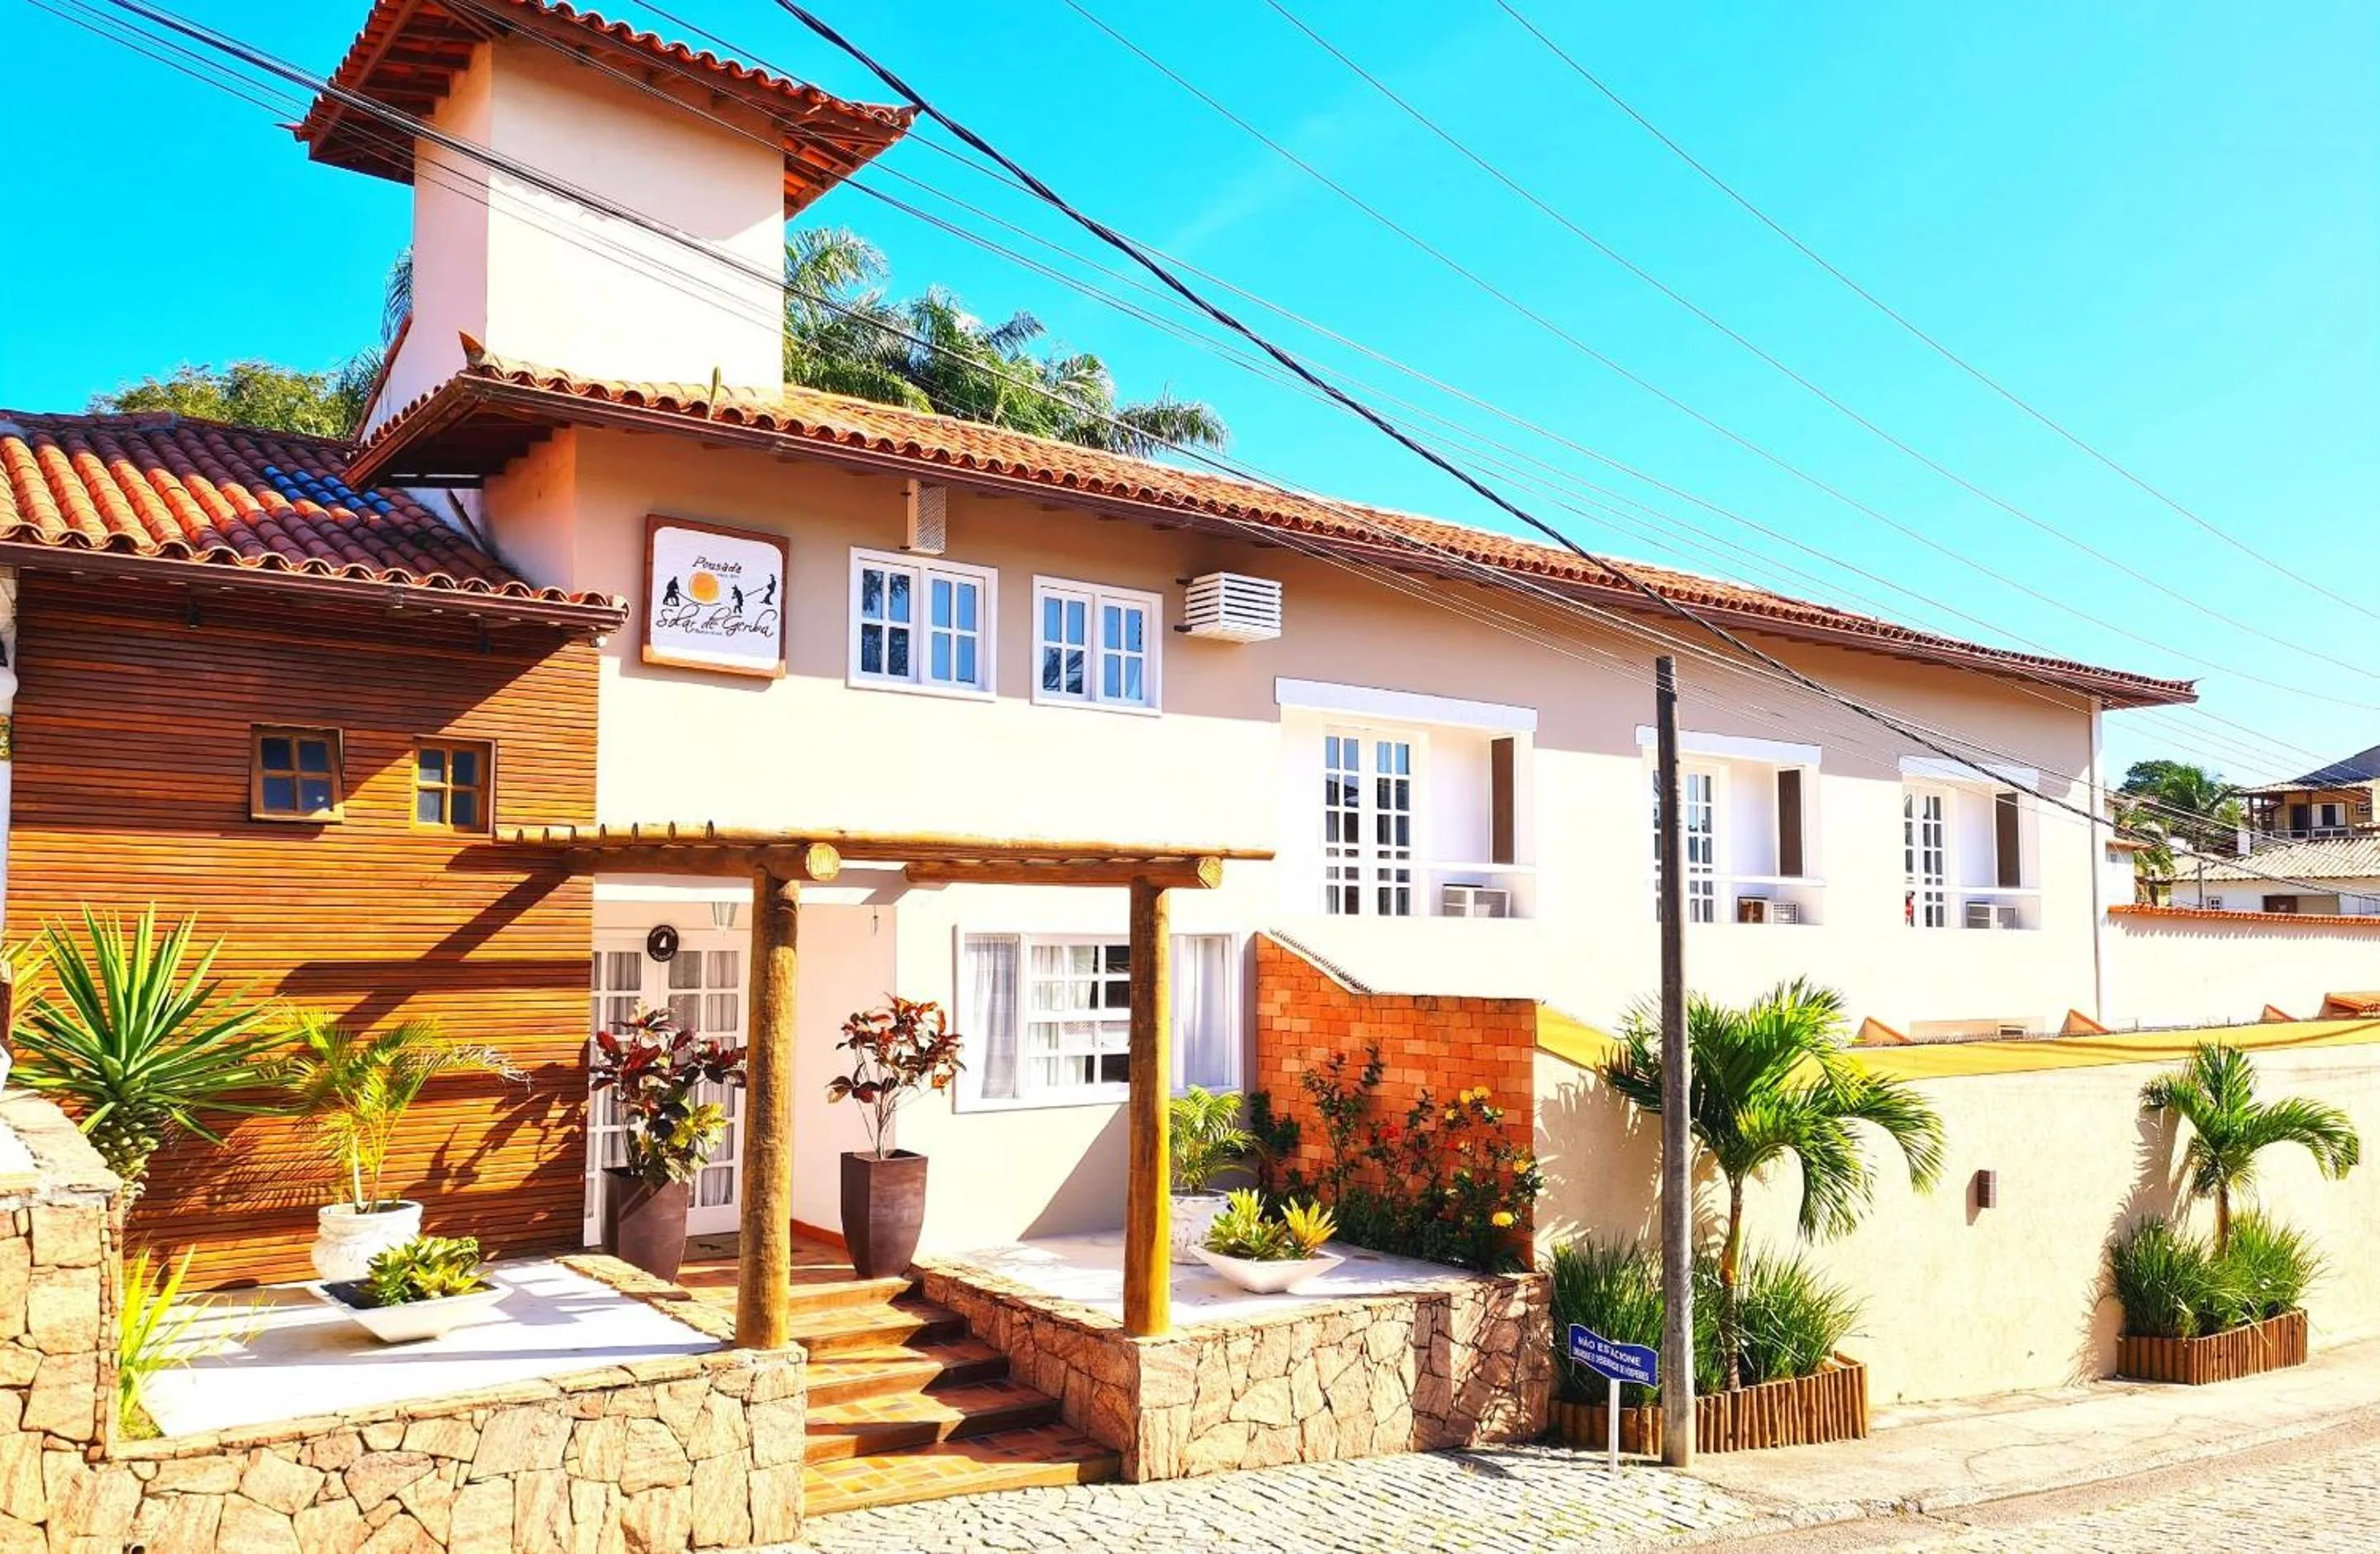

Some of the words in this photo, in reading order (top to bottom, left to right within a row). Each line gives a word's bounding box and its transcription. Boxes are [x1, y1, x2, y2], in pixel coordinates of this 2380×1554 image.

[656, 603, 700, 633] Solar
[701, 606, 732, 629] de
[1578, 1336, 1595, 1350] NÃO
[1597, 1342, 1641, 1367] ESTACIONE
